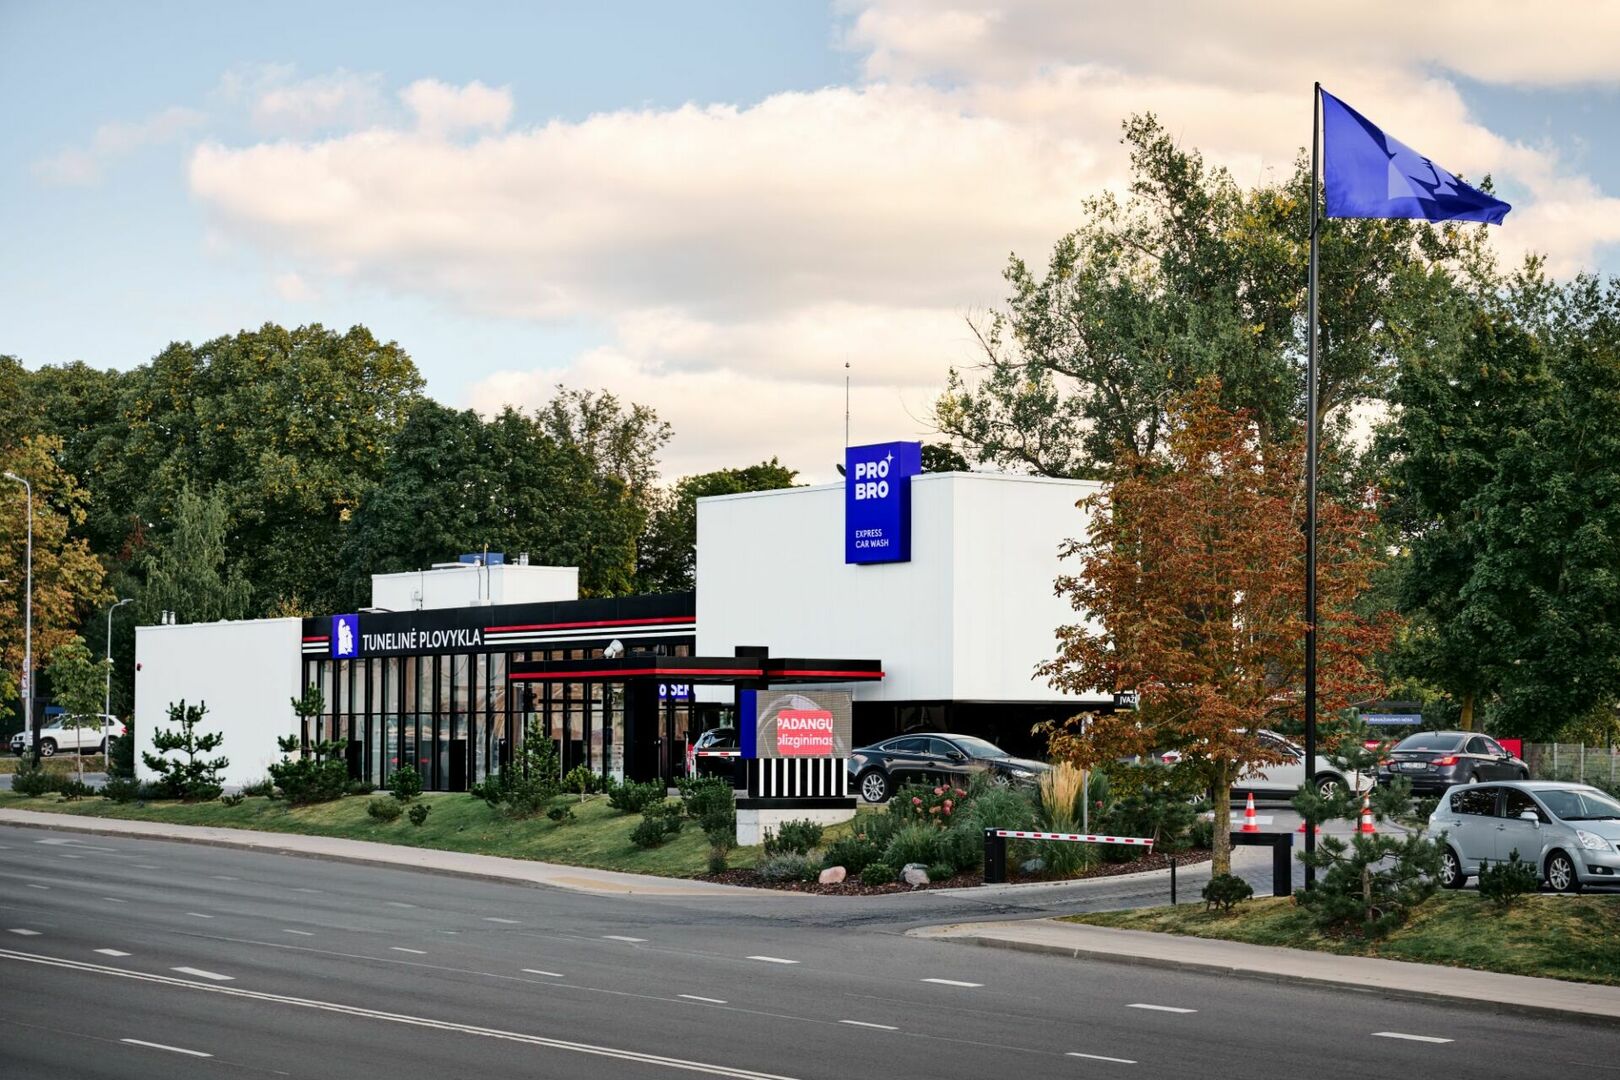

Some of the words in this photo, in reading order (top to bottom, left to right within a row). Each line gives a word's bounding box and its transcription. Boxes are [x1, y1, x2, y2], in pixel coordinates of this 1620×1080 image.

[856, 460, 889, 480] PRO
[856, 481, 889, 500] BRO
[856, 529, 882, 538] EXPRESS
[856, 540, 870, 549] CAR
[870, 539, 889, 548] WASH
[363, 628, 416, 650] TUNELINĖ
[419, 628, 481, 648] PLOVYKLA
